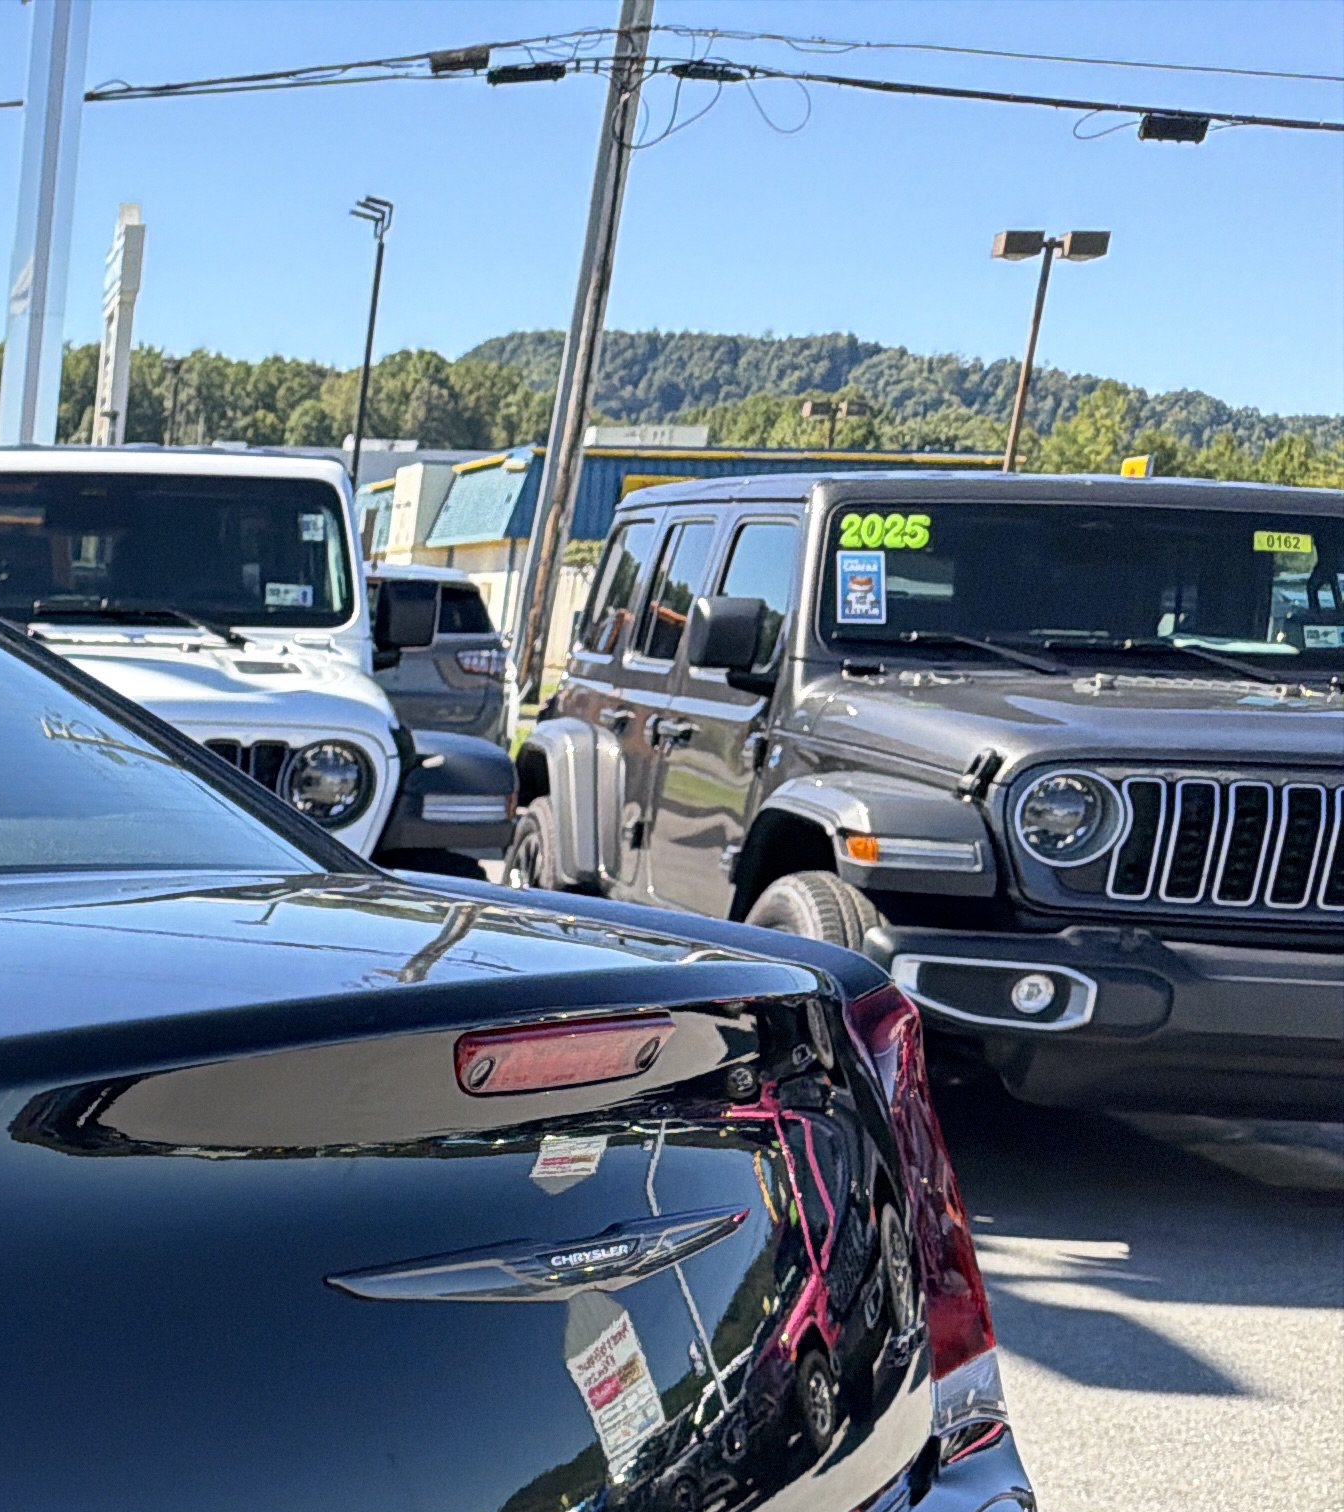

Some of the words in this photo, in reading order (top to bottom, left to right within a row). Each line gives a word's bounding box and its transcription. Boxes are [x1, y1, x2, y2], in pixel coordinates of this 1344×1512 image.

[839, 512, 931, 549] 2025
[1266, 534, 1301, 550] 0162
[550, 1244, 629, 1268] CHRYSLER
